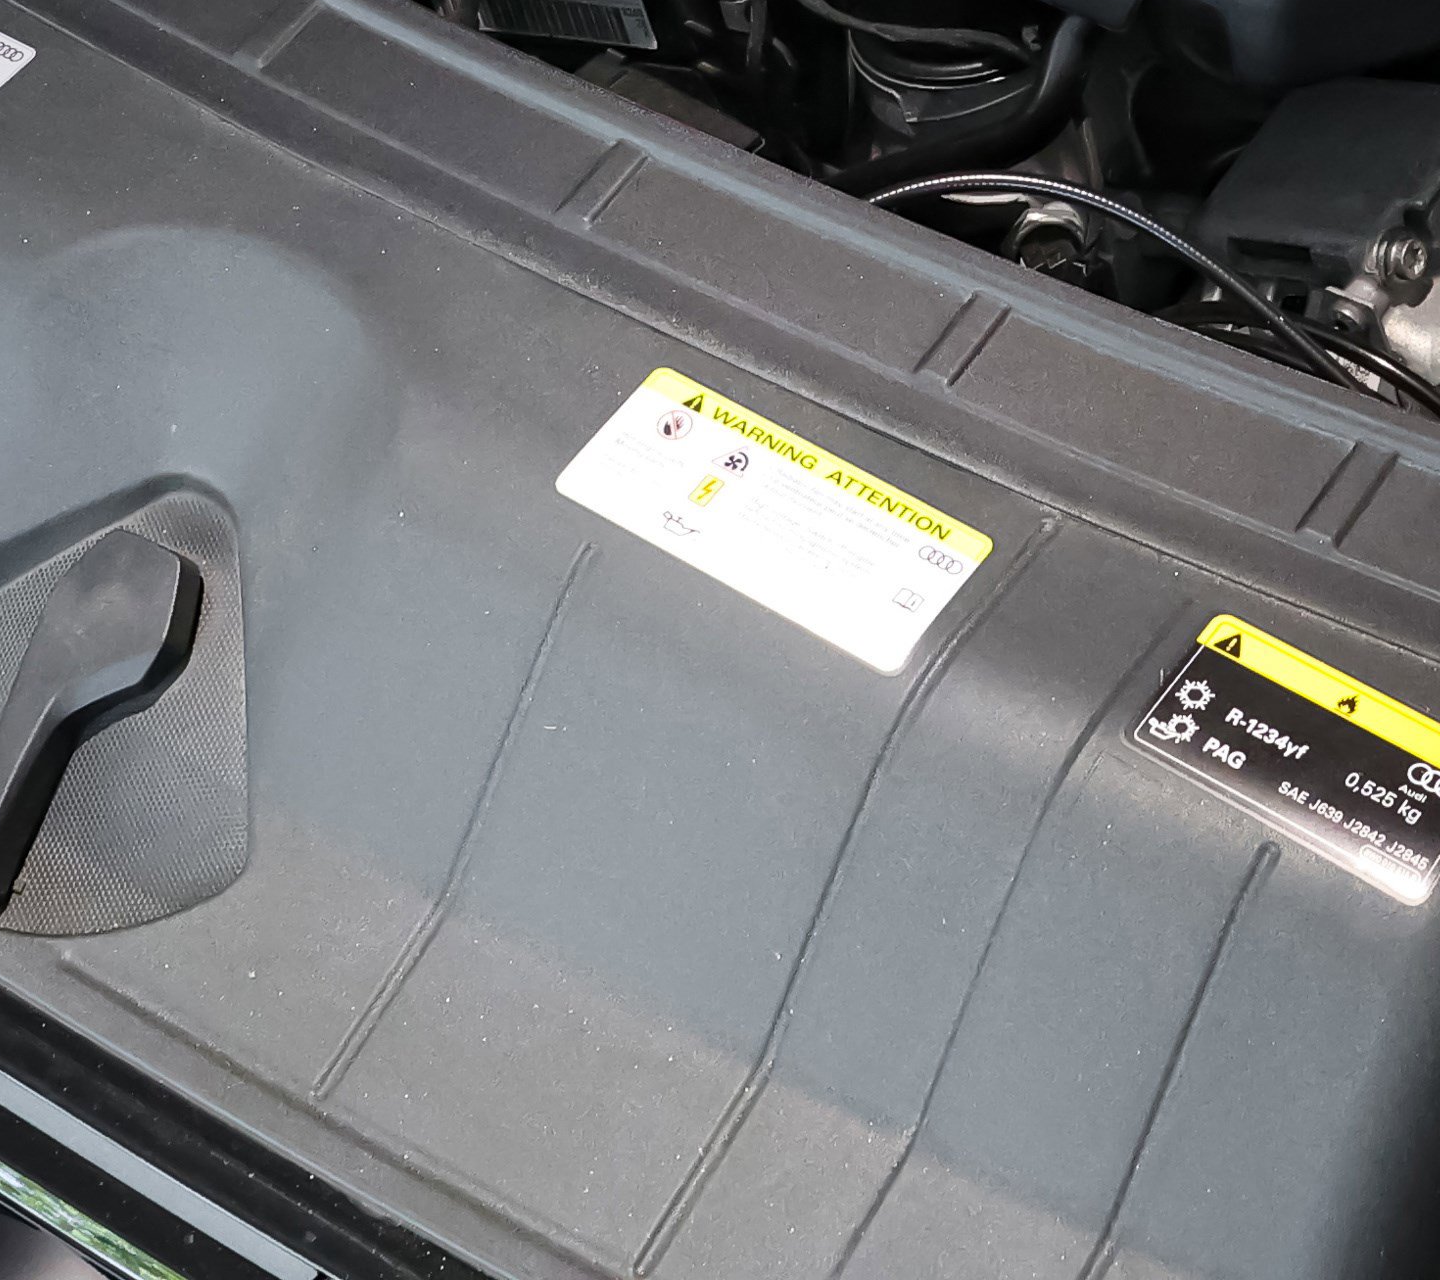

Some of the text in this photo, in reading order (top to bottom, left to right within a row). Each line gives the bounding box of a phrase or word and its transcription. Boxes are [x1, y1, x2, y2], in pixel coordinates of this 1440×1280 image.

[713, 405, 818, 472] WARNING
[825, 469, 952, 541] ATTENTION
[1202, 736, 1247, 770] PAG
[1224, 707, 1310, 760] R-1234yf
[1344, 772, 1422, 826] 0,525 kg
[1398, 784, 1428, 804] Audi
[1278, 781, 1310, 805] SAE
[1309, 799, 1344, 823] J639
[1343, 817, 1387, 848] J2842
[1385, 840, 1431, 871] J2845
